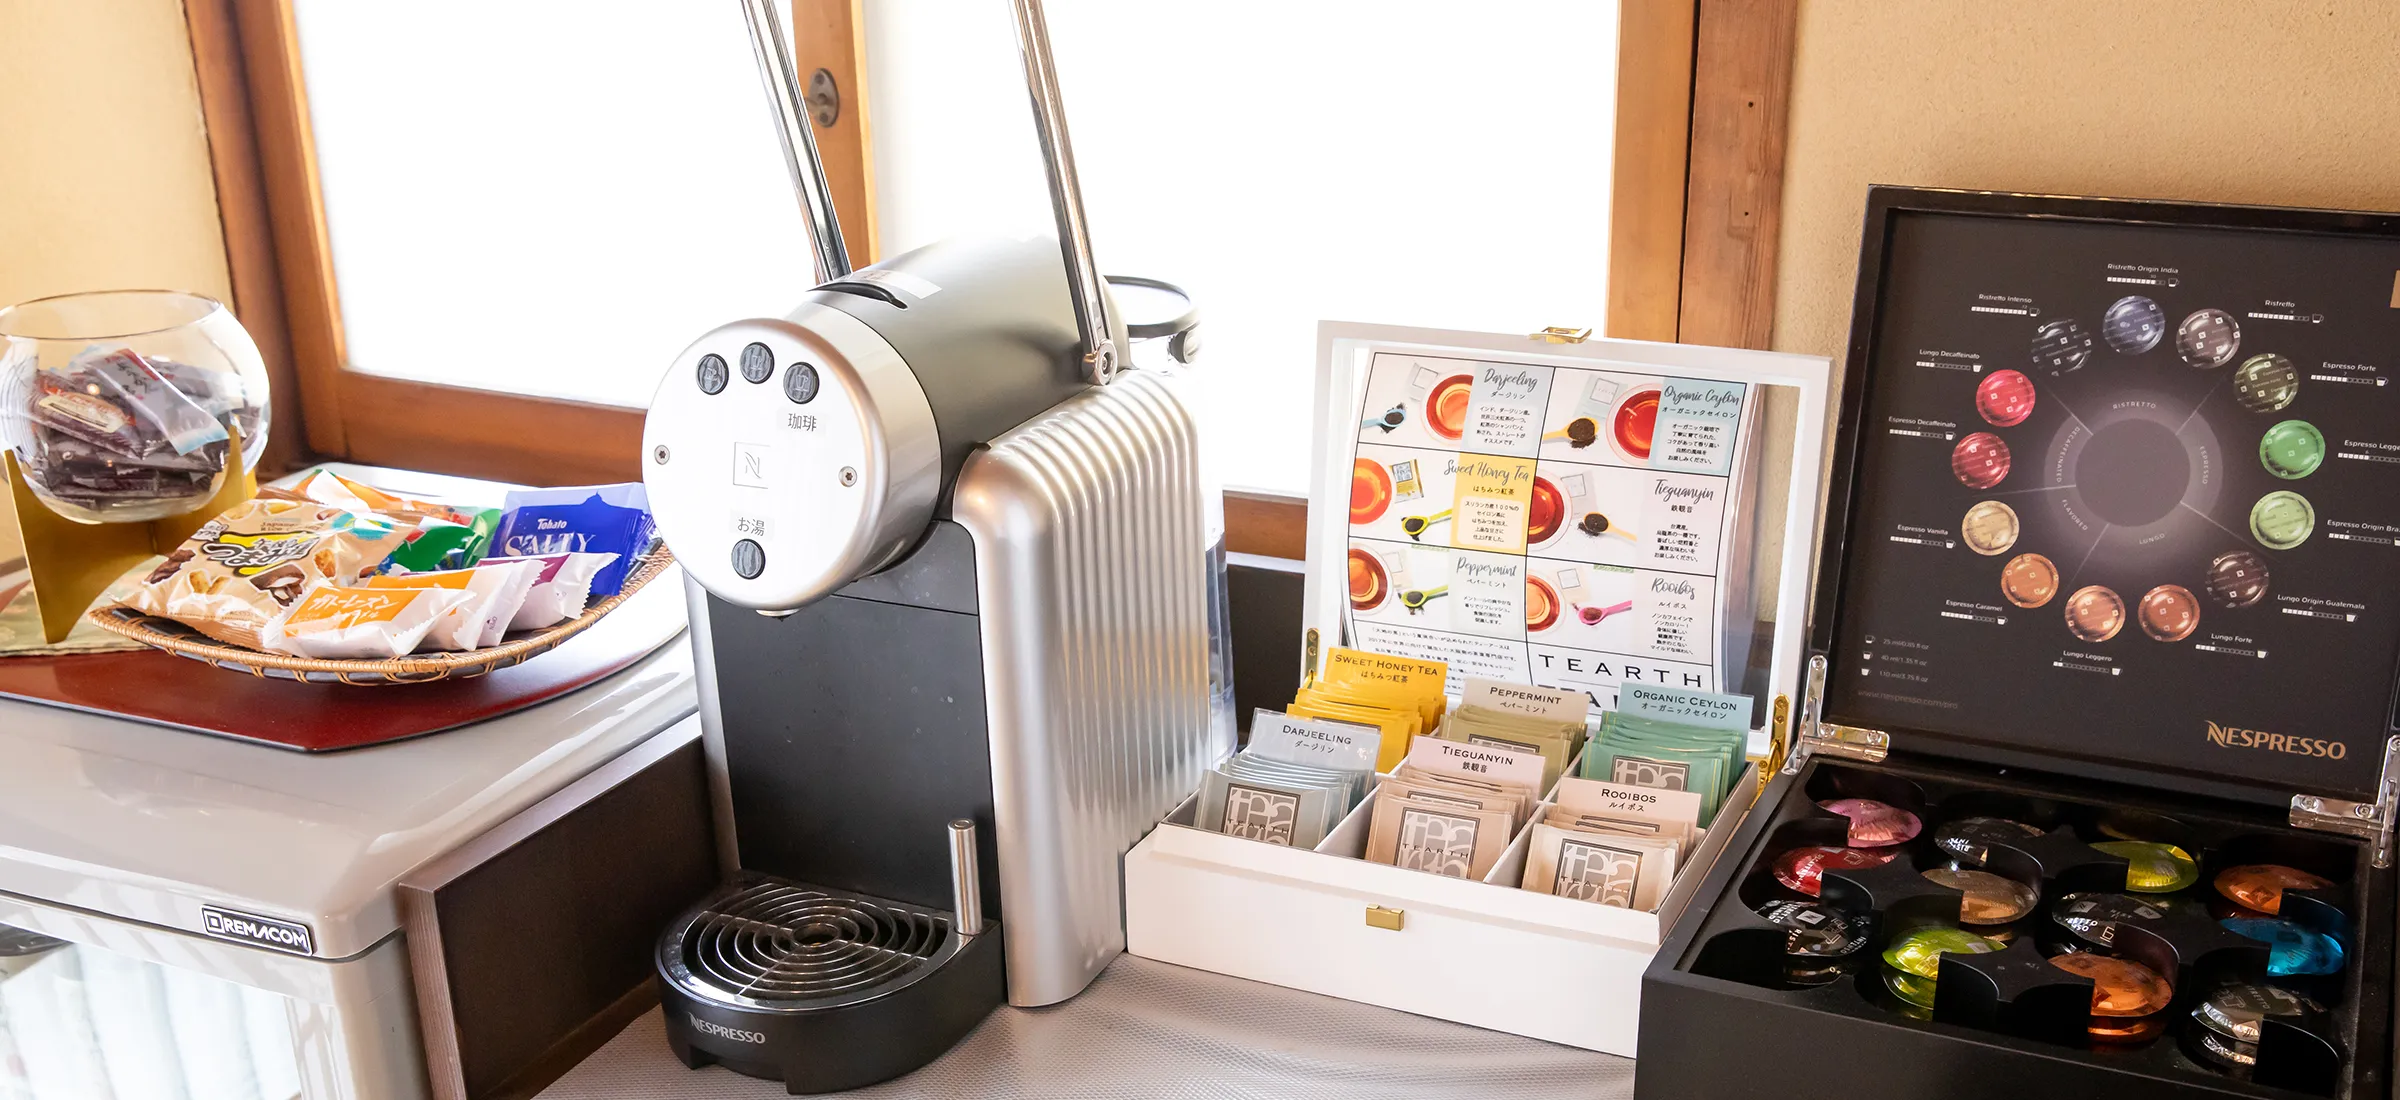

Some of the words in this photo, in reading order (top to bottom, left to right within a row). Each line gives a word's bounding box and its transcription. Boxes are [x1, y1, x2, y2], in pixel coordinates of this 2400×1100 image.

[2107, 263, 2136, 272] Ristretto
[2137, 265, 2160, 275] Origin
[2161, 266, 2179, 274] India
[1978, 293, 2006, 302] Ristretto
[2007, 296, 2032, 304] Intenso
[2265, 299, 2296, 309] Ristretto
[1919, 349, 1940, 358] Lungo
[1940, 350, 1980, 360] Decaffeinato
[2322, 362, 2356, 372] Espresso
[2357, 364, 2376, 372] Forte
[1484, 368, 1538, 392] Darjeeling
[1490, 391, 1526, 400] ダージリン
[1664, 385, 1704, 405] Organic
[1705, 388, 1740, 408] Ceylon
[1662, 406, 1736, 418] オーガニックセイロン
[2112, 400, 2156, 410] RISTRETTO
[787, 412, 818, 432] 珈琲
[1888, 416, 1916, 426] Espresso
[1917, 418, 1956, 428] Decaffeinato
[2344, 440, 2378, 449] Espresso
[2055, 426, 2081, 483] DECAFFEINATED
[1443, 460, 1474, 476] Sweet
[1475, 462, 1510, 486] Honey
[1514, 464, 1530, 482] Tea
[2200, 445, 2210, 485] ESPRESSO
[1472, 486, 1514, 496] はちみつ紅茶
[1654, 478, 1714, 503] Tieguanyin
[2062, 498, 2088, 531] FLAVORED
[537, 518, 568, 531] Tohato
[737, 517, 766, 537] お湯
[1897, 524, 1926, 534] Espresso
[1927, 526, 1949, 536] Vanilla
[2327, 519, 2360, 529] Espresso
[2361, 522, 2384, 532] Origin
[504, 532, 596, 556] SALTY
[2139, 532, 2166, 545] LUNGO
[1456, 556, 1517, 577] Peppermint
[1651, 577, 1696, 600] Rooibos
[308, 594, 400, 610] ガトーレーズン
[1658, 602, 1687, 610] ルイボス
[1946, 599, 1974, 610] Espresso
[1976, 602, 2003, 612] Caramel
[2277, 594, 2300, 604] Lungo
[2301, 597, 2323, 607] Origin
[2324, 600, 2365, 610] Guatemala
[2210, 633, 2233, 643] Lungo
[2234, 635, 2252, 644] Forte
[2062, 650, 2084, 660] Lungo
[2086, 652, 2112, 662] Leggero
[1334, 654, 1372, 667] SWEET
[1376, 660, 1414, 673] HONEY
[1418, 666, 1438, 676] TEA
[1538, 654, 1702, 688] TEARTH
[1360, 670, 1408, 684] はちみつ紅茶
[1490, 686, 1562, 705] PEPPERMINT
[1633, 689, 1685, 704] ORGANIC
[1689, 696, 1738, 711] CEYLON
[1500, 701, 1548, 714] ペパーミント
[1641, 702, 1728, 720] オーガニックセイロン
[1282, 724, 1352, 745] DARJEELING
[2204, 719, 2346, 760] NESPRESSO
[1294, 740, 1335, 754] ダージリン
[1442, 745, 1514, 766] TIEGUANYIN
[1462, 761, 1488, 774] 鉄観音
[1601, 788, 1656, 804] ROOIBOS
[1608, 802, 1645, 812] ルイボス
[1227, 818, 1290, 835] TEARTH
[1402, 842, 1470, 860] TEARTH
[223, 917, 308, 946] REMACOM
[688, 1012, 766, 1044] NESPRESSO
